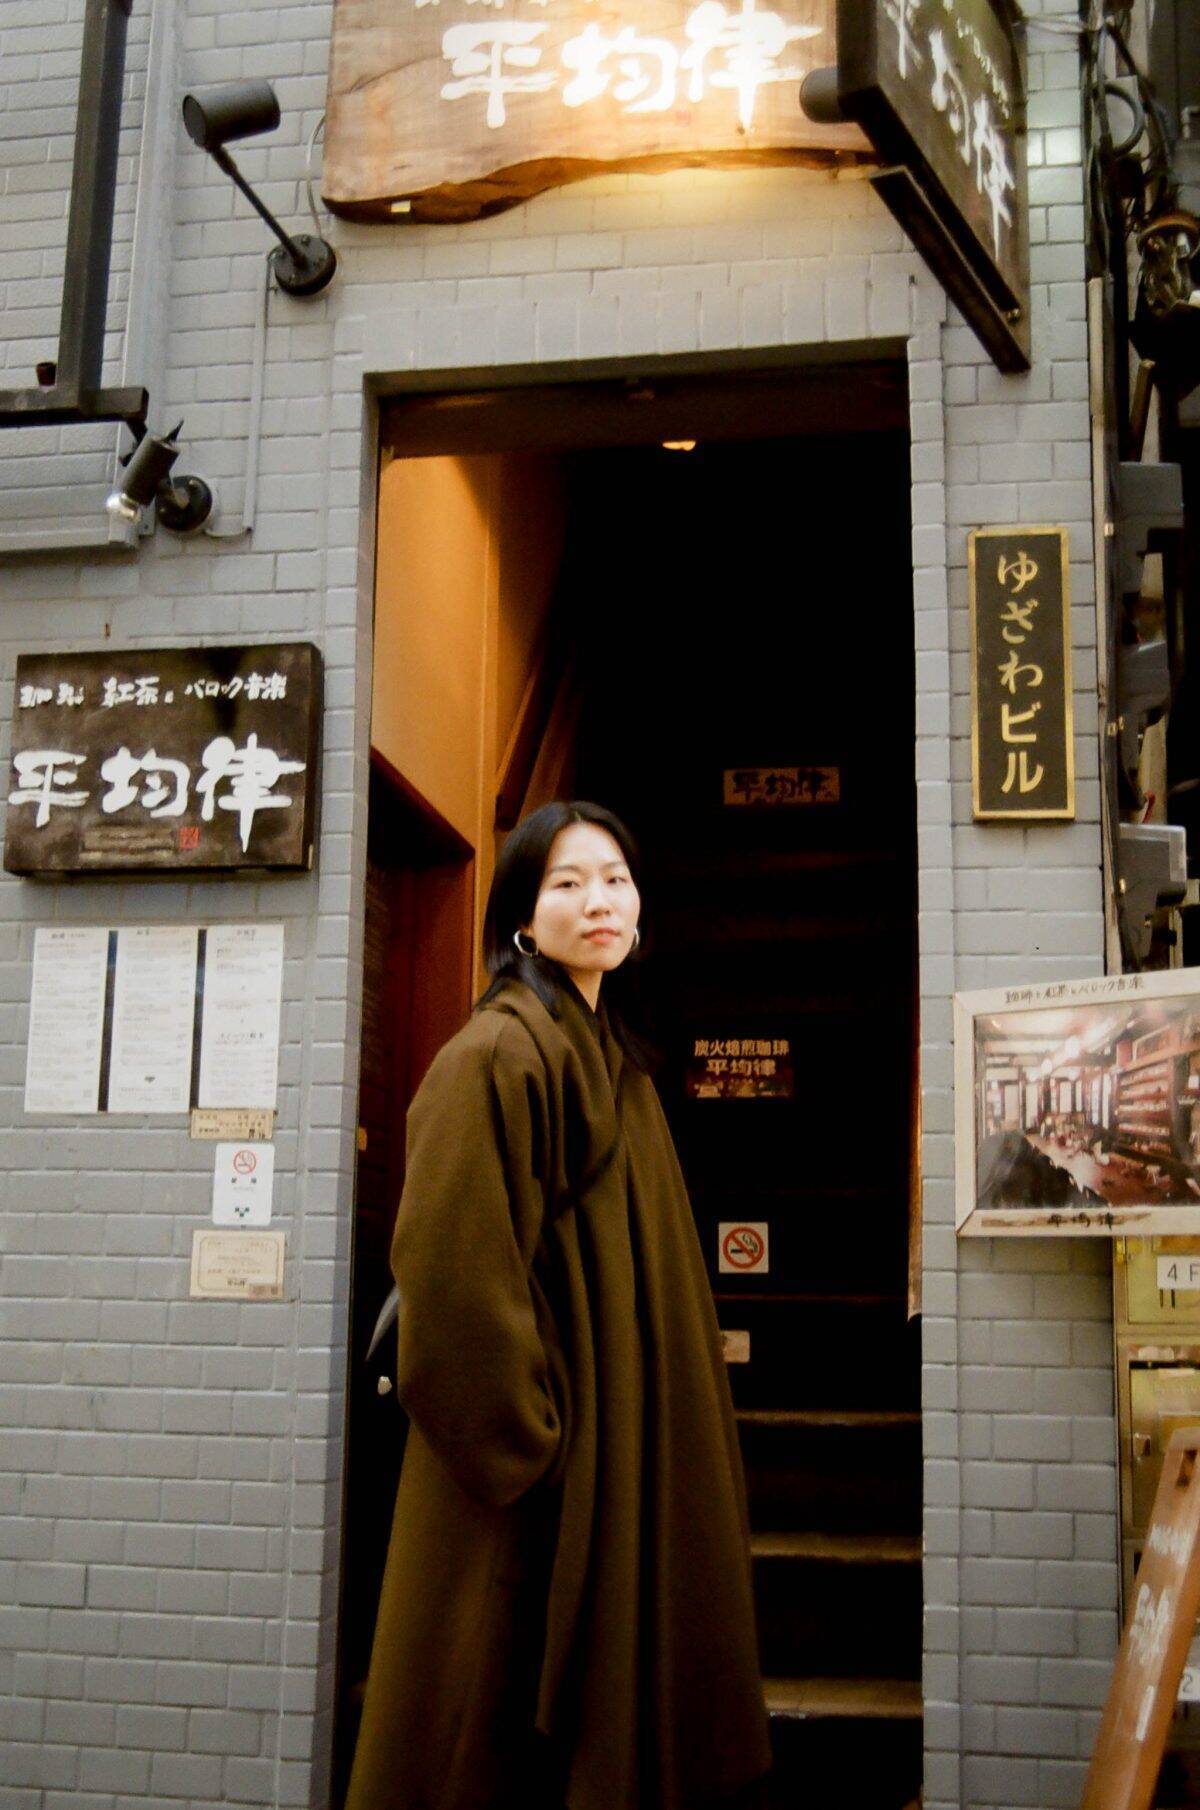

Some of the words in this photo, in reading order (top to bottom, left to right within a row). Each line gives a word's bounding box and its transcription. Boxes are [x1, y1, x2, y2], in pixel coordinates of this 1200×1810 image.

[441, 0, 823, 133] 平均律
[996, 551, 1045, 795] ゆざわビル
[7, 732, 307, 854] 平均律
[704, 1058, 778, 1077] 平均律
